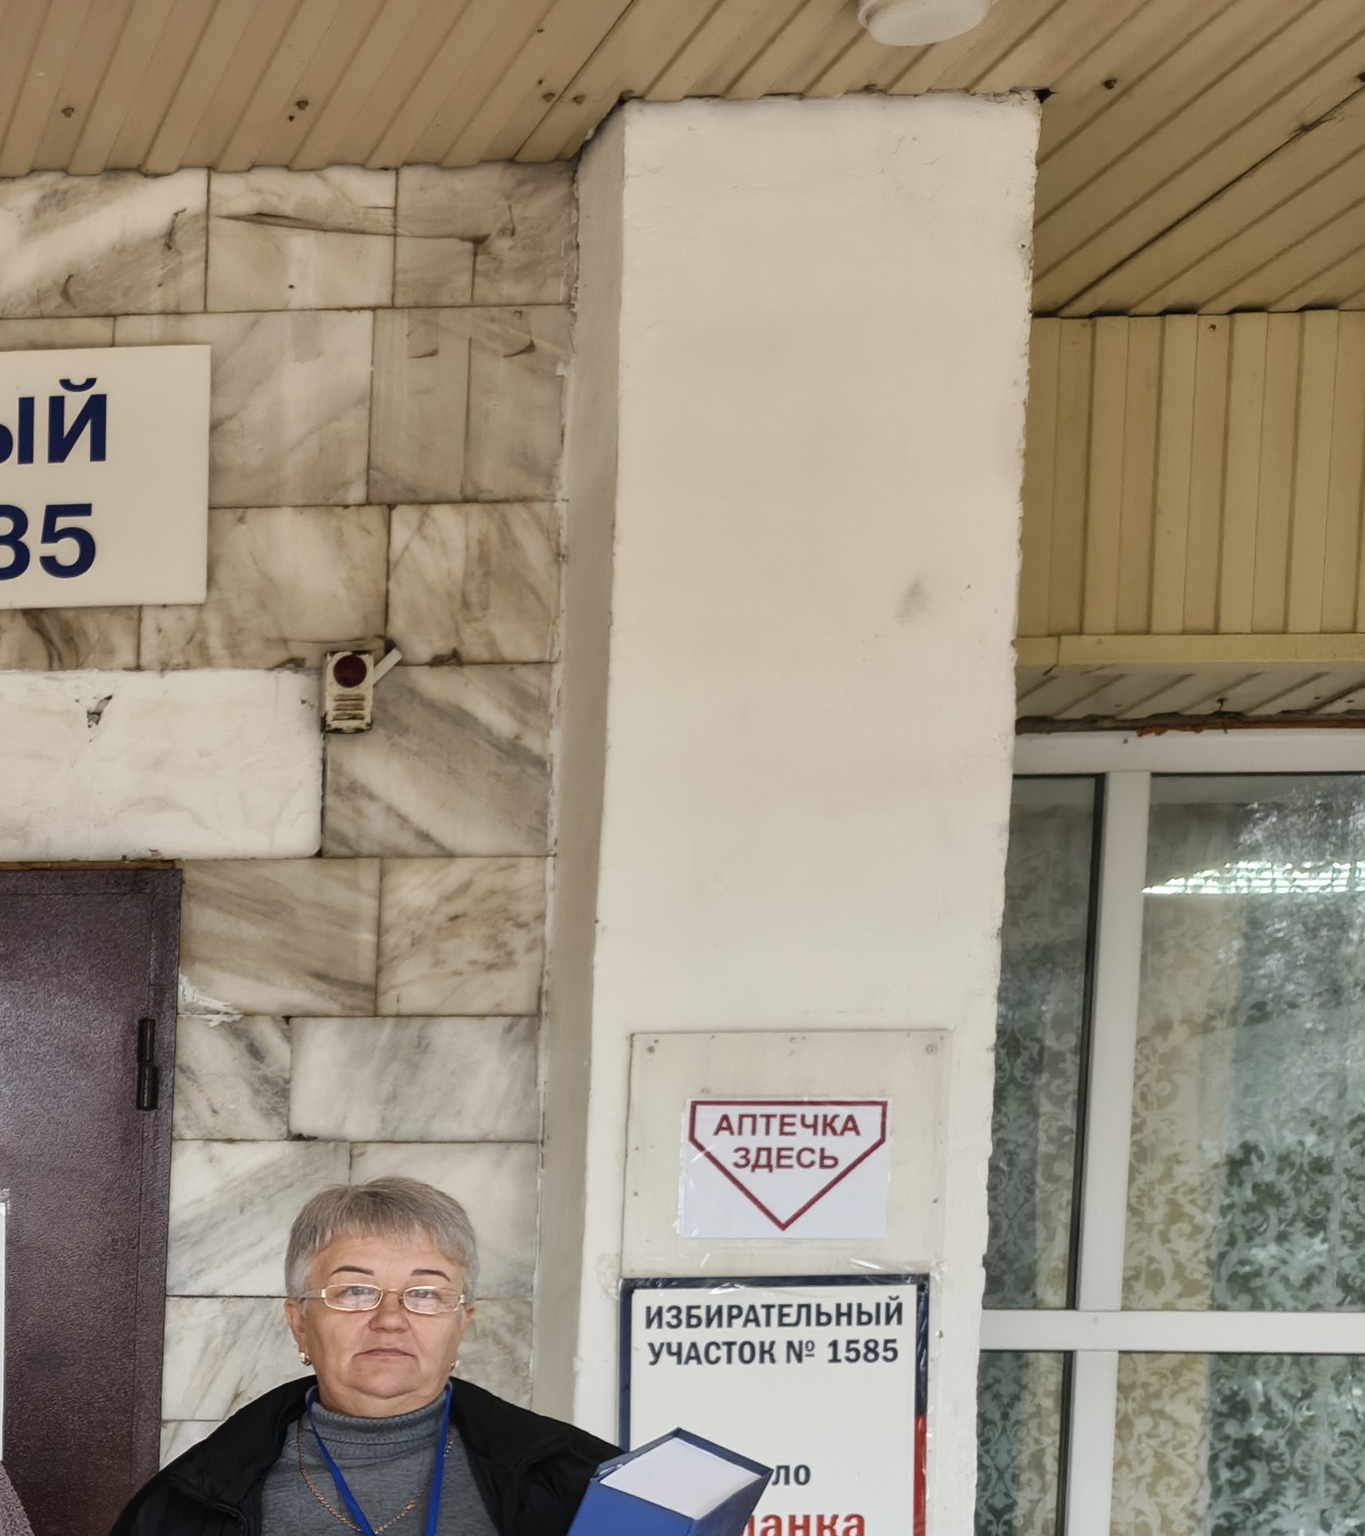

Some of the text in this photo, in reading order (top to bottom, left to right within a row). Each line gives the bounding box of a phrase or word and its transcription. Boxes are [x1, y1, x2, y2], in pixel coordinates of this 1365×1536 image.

[712, 1113, 862, 1138] АПТЕЧКА
[732, 1145, 840, 1174] ЗДЕСЬ
[644, 1295, 904, 1330] ИЗБИРАТЕЛЬНЫЙ
[647, 1337, 900, 1367] УЧАСТОК № 1585
[771, 1463, 812, 1487] ло
